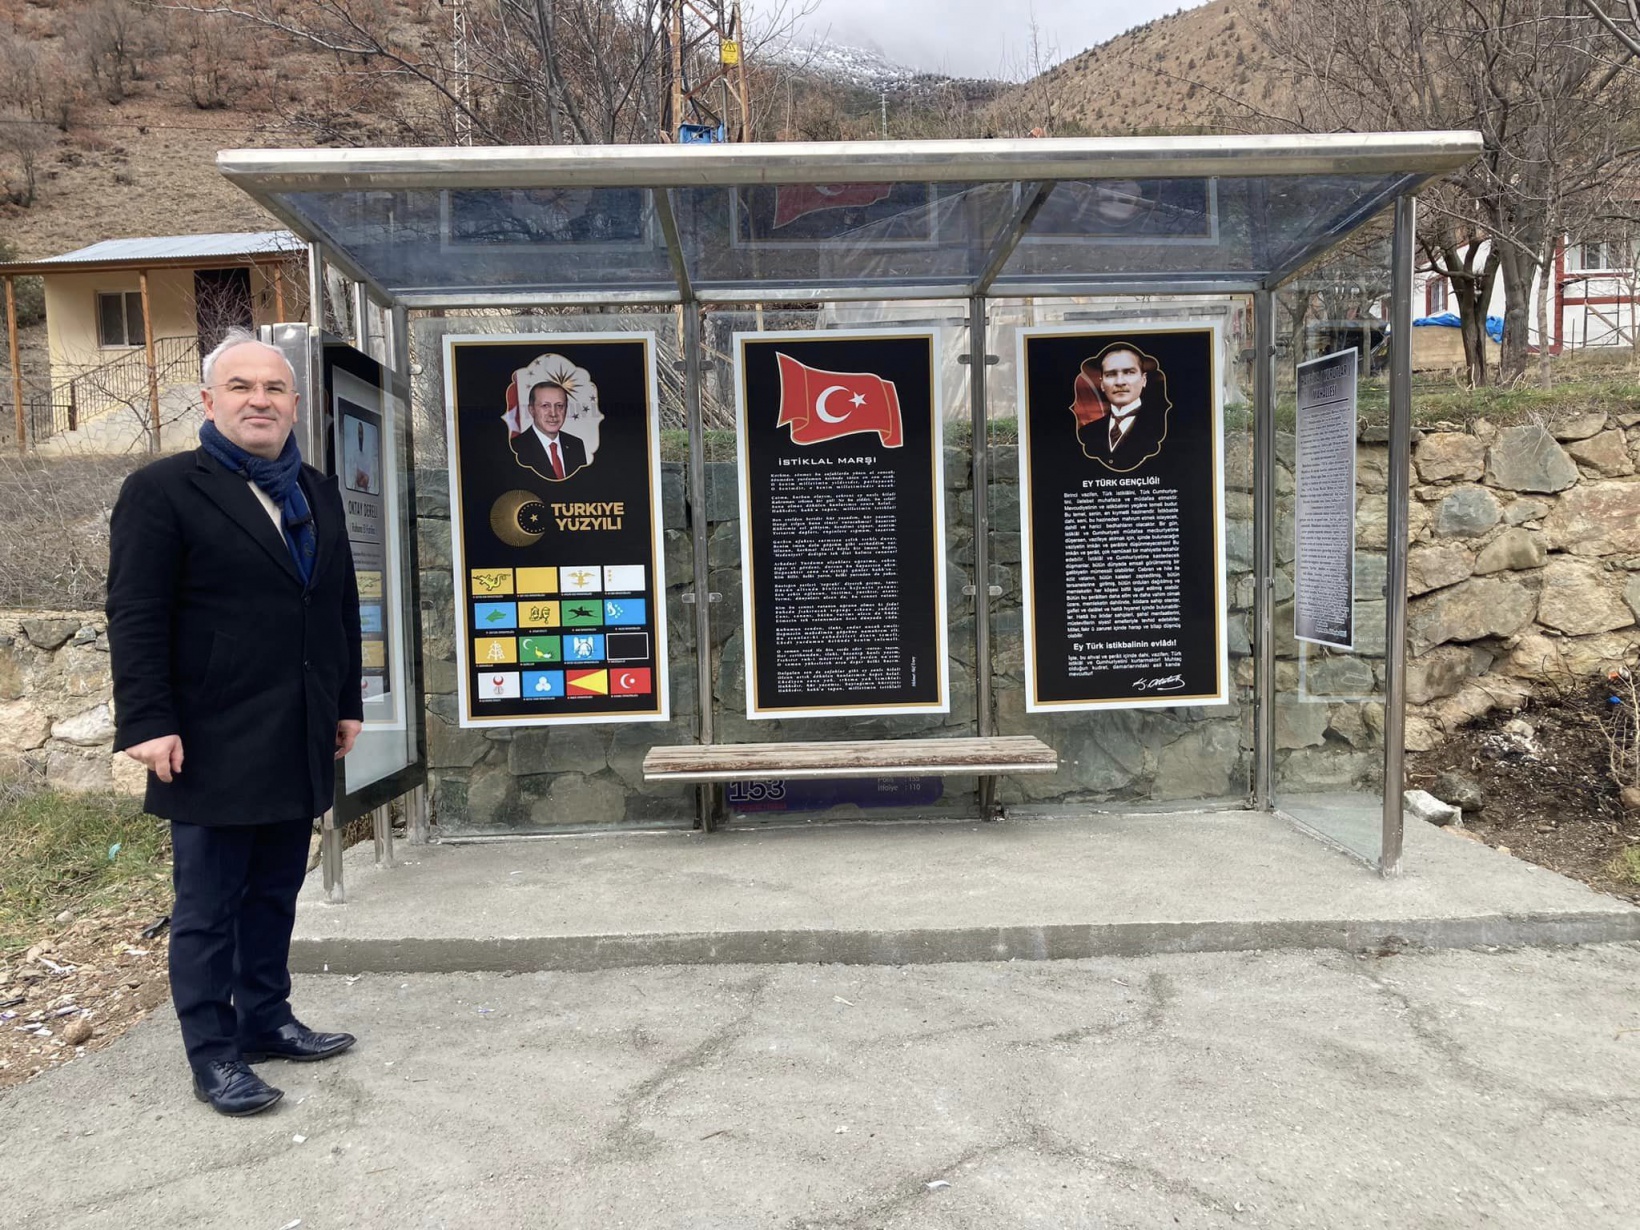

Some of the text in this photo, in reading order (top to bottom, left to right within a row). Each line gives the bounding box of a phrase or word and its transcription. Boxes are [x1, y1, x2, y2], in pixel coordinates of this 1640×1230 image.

[778, 456, 876, 466] İSTİKLAL MARŞI
[1095, 479, 1118, 487] TÜRK
[1119, 476, 1160, 486] GENÇLİĞİ!
[551, 502, 624, 516] TÜRKİYE
[556, 517, 622, 531] YÜZYILI
[1073, 642, 1083, 650] Ey
[1105, 640, 1148, 649] istikbalinin
[730, 780, 786, 801] 153
